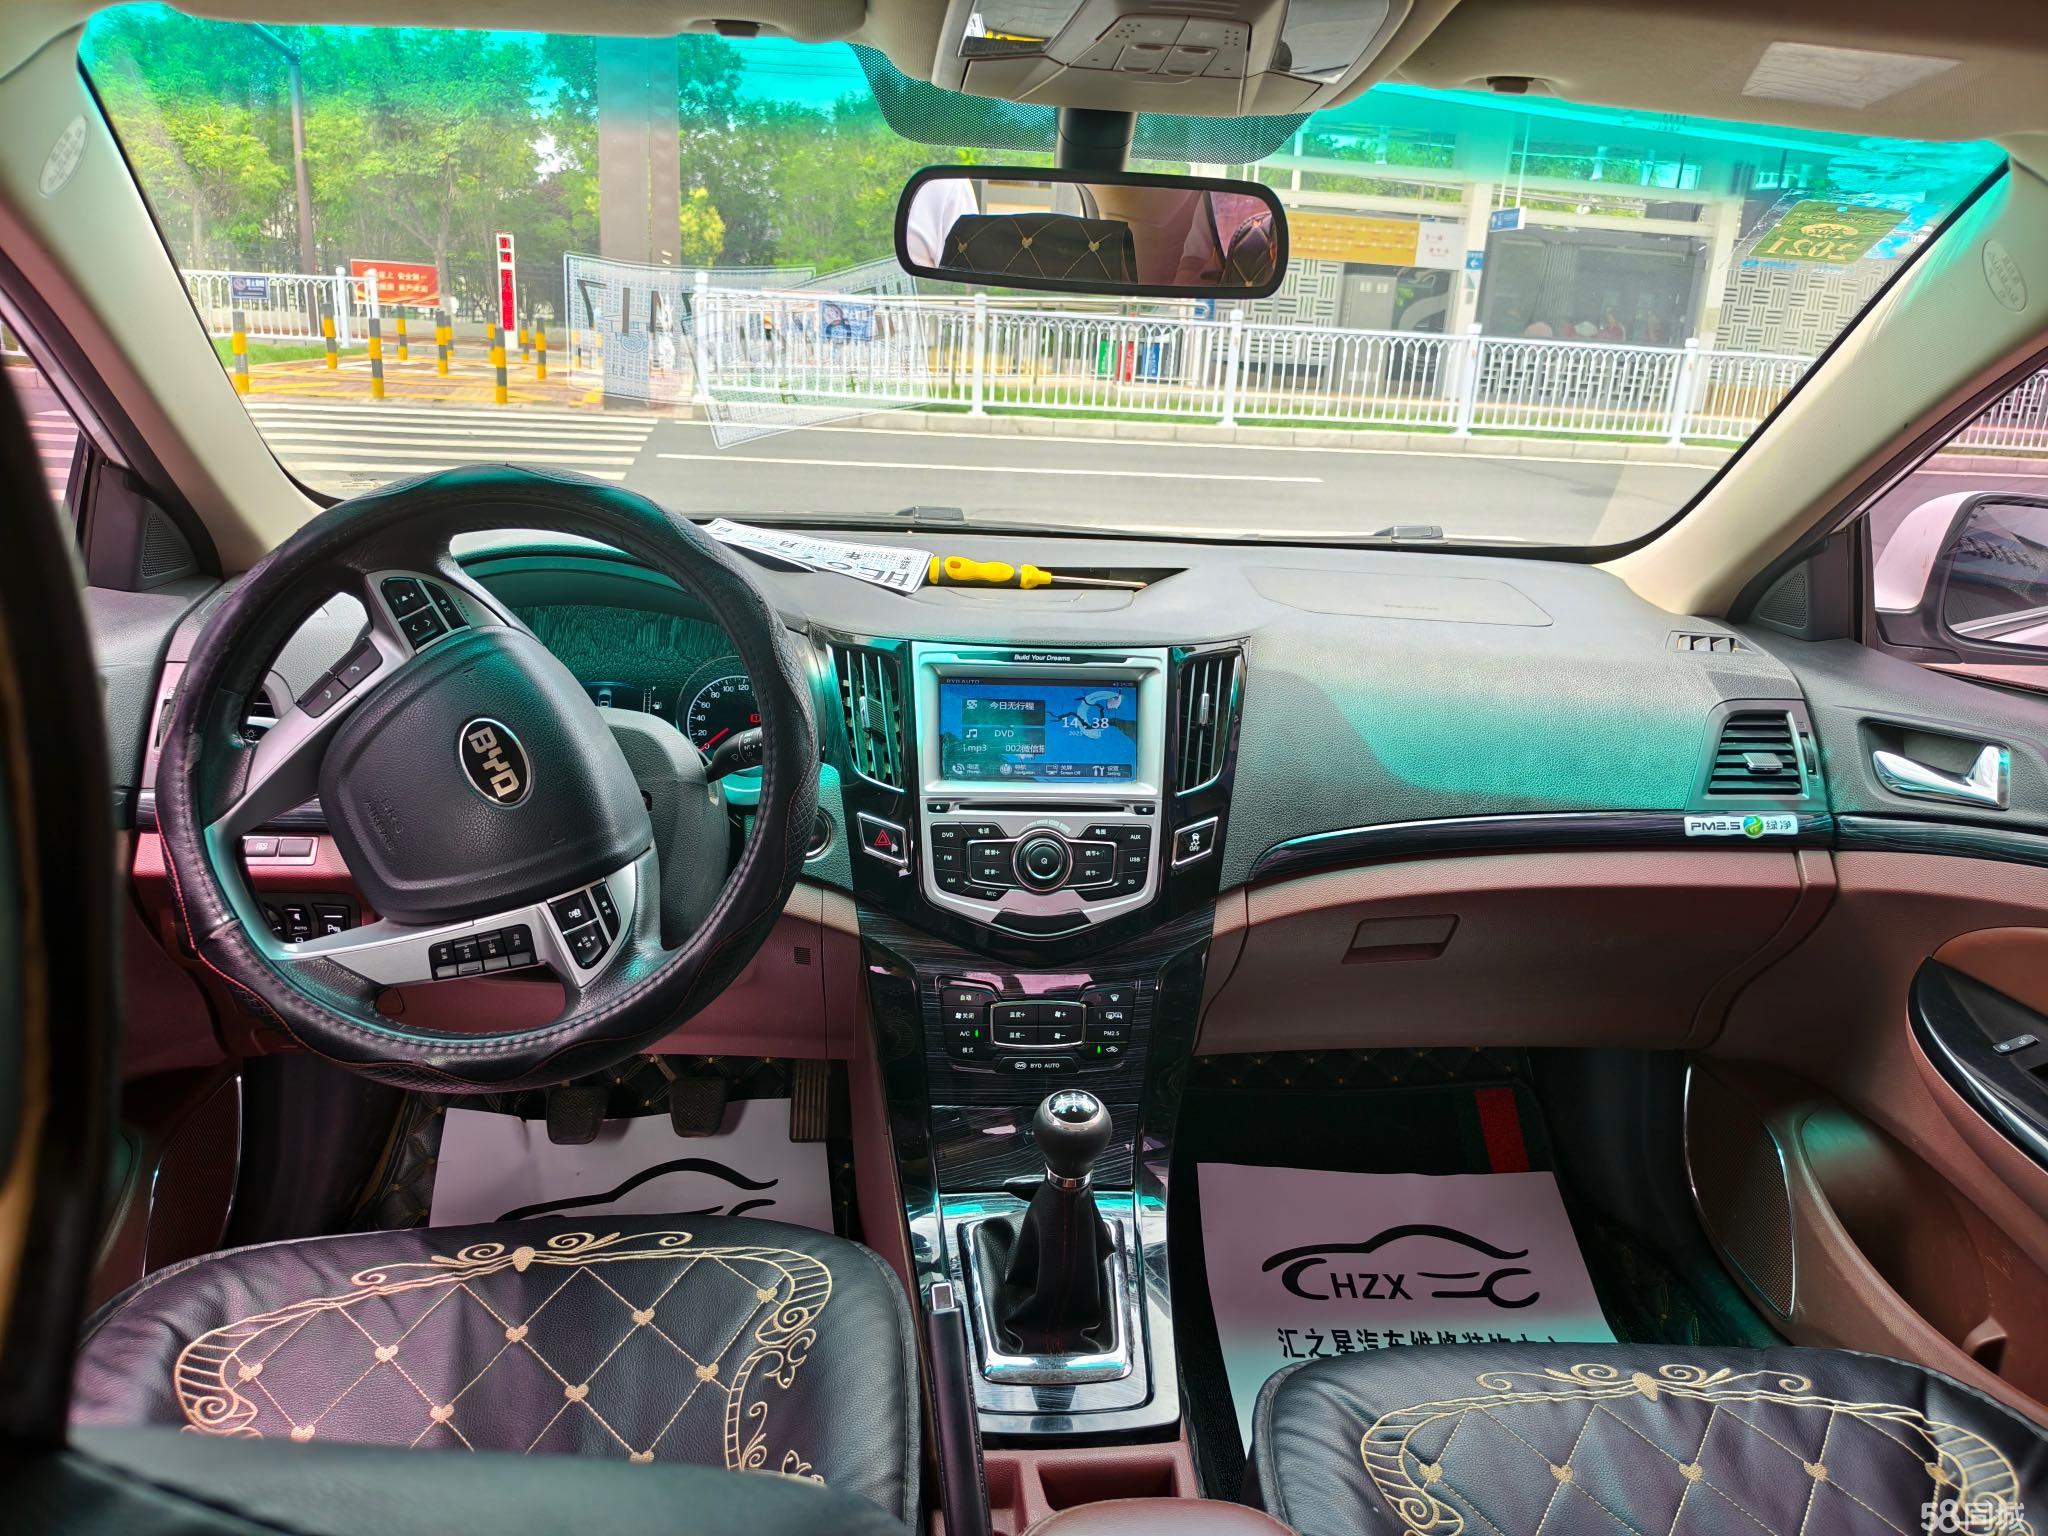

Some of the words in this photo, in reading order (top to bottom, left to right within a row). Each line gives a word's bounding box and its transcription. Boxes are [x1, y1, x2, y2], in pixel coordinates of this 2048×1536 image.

[468, 726, 520, 798] BYD
[1690, 822, 1741, 831] PM2.5
[1766, 820, 1792, 830] 绿净
